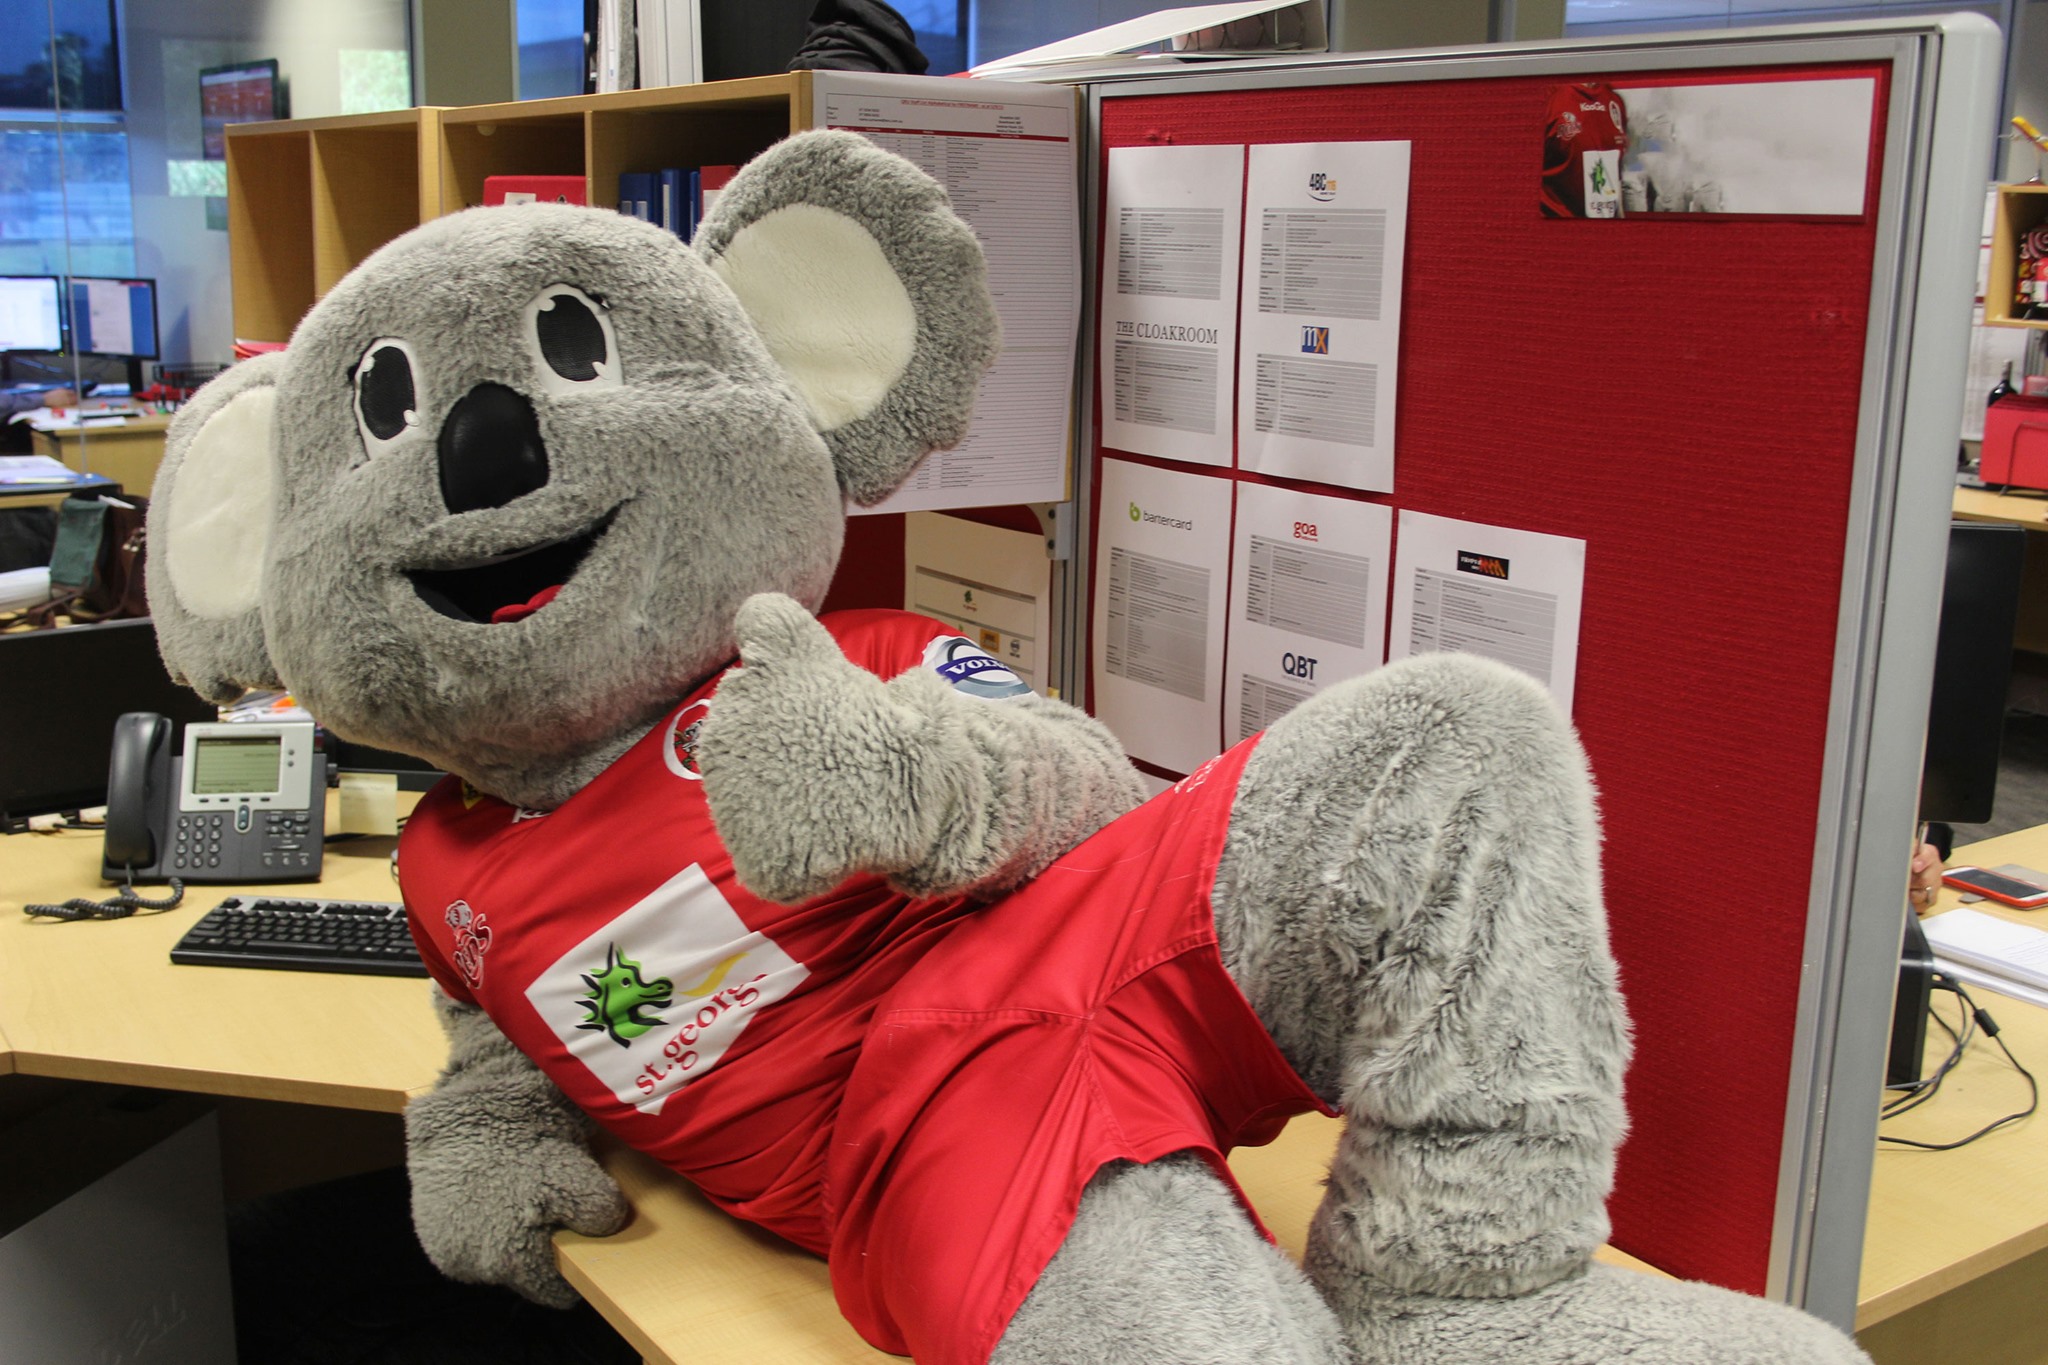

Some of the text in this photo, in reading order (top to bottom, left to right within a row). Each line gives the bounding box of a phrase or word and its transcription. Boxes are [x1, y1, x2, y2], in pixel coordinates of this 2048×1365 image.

[1115, 321, 1218, 344] THE CLOAKROOM
[1143, 510, 1192, 531] bartercard
[1293, 521, 1317, 538] goa
[1282, 652, 1318, 680] QBT
